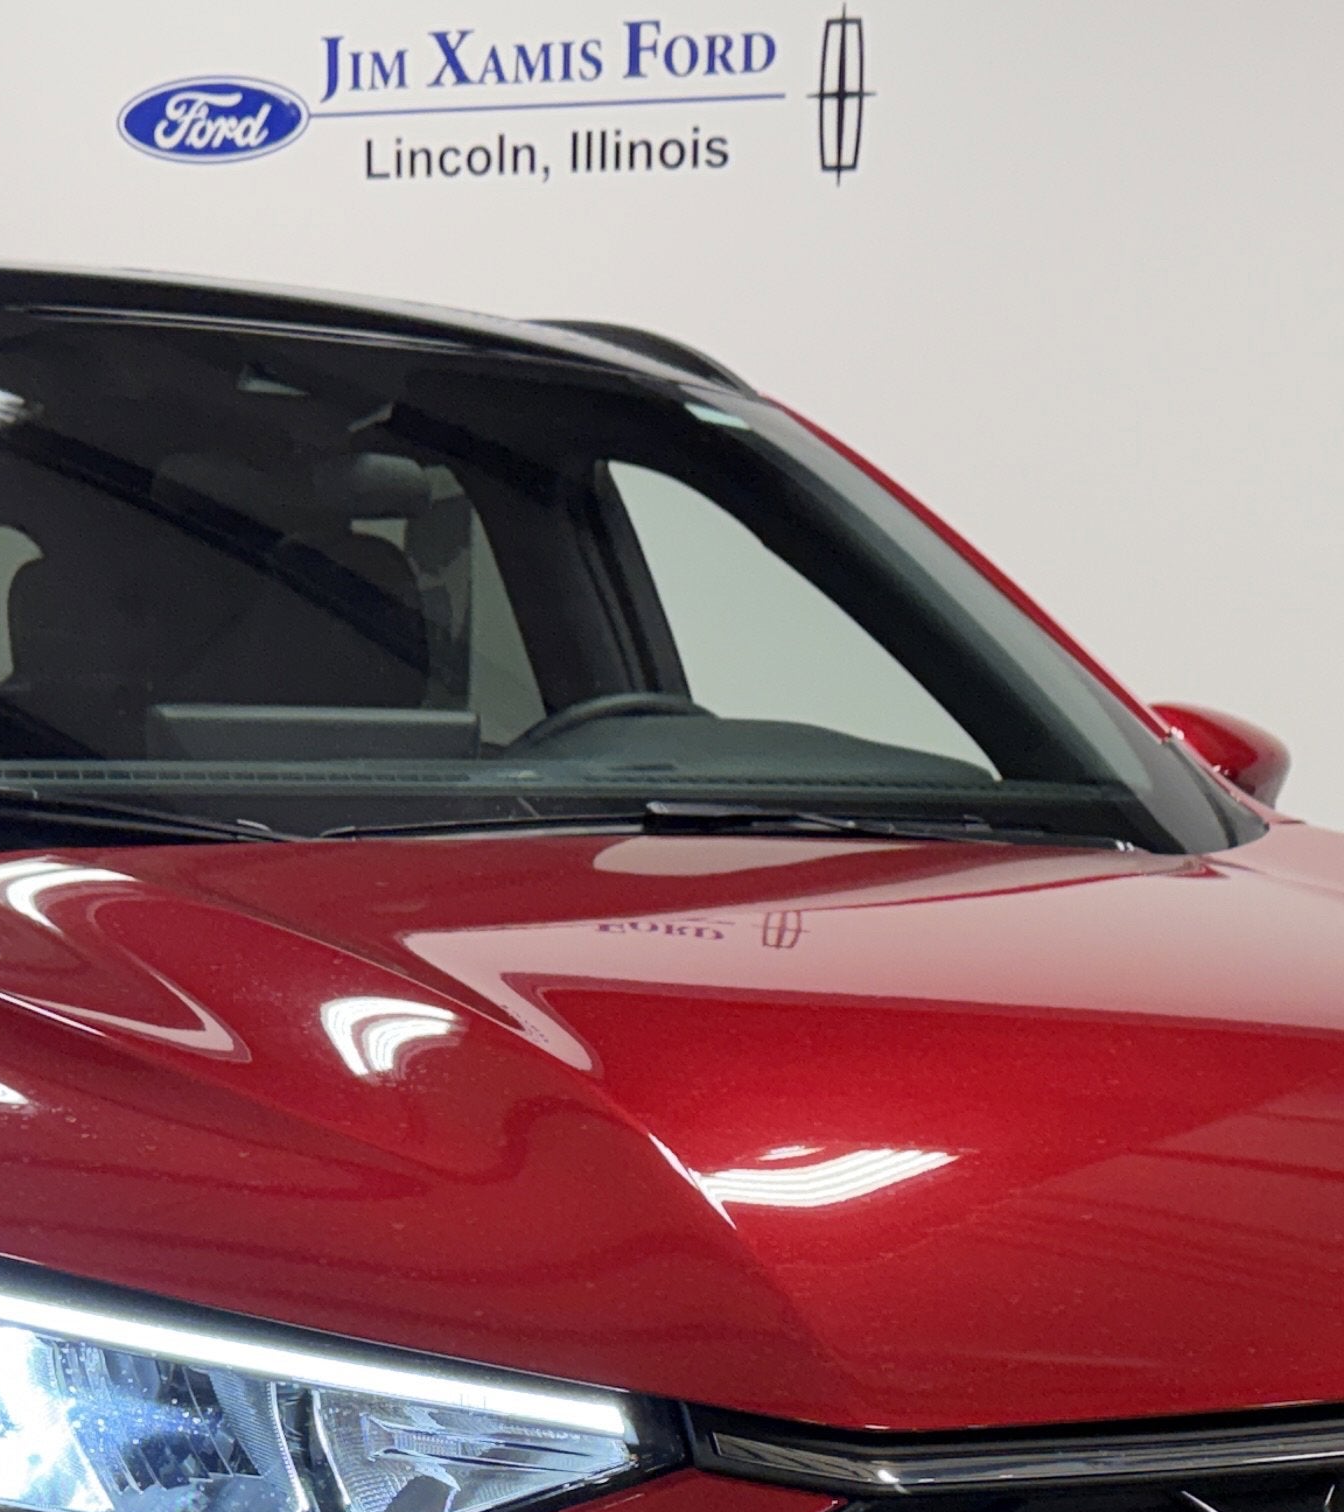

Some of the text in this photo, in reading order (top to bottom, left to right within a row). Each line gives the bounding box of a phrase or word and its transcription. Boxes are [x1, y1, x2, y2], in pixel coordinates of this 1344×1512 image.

[320, 20, 777, 103] JIM XAMIS FORD
[154, 91, 272, 149] Ford
[366, 126, 730, 183] Lincoln, Illinois
